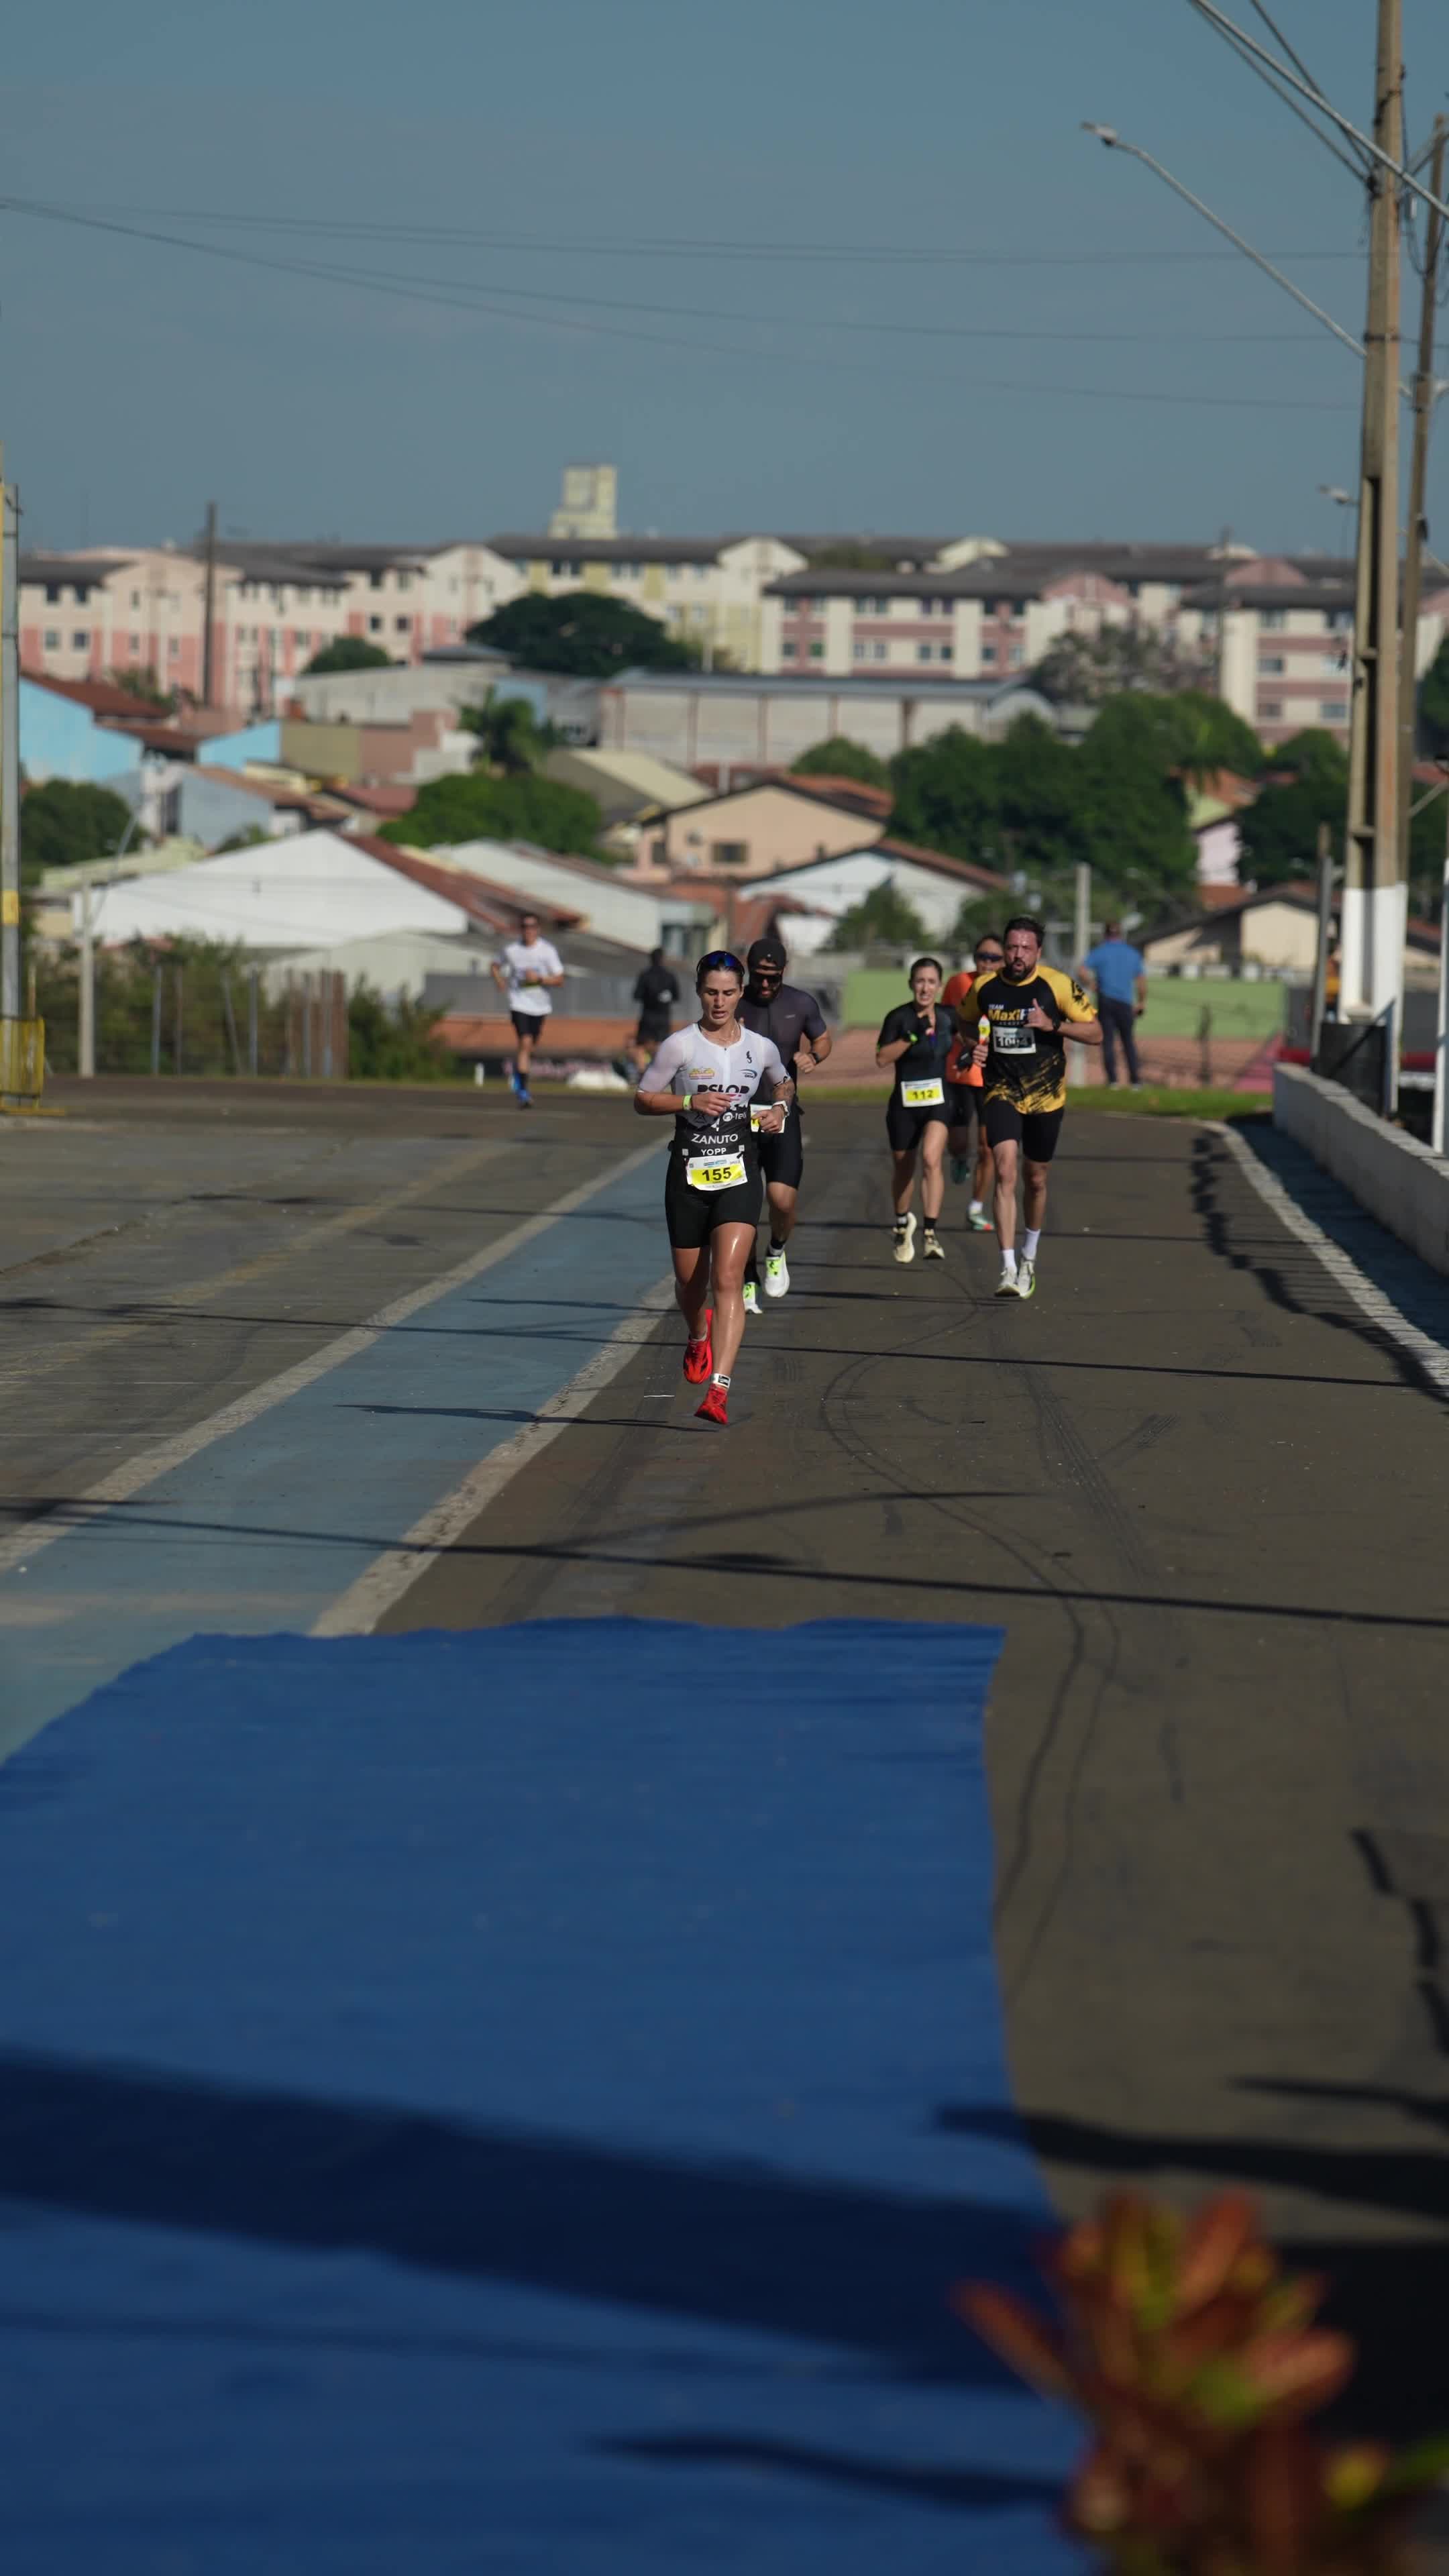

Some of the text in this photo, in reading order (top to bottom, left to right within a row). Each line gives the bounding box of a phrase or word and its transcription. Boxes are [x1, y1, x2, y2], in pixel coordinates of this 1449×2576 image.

[987, 1008, 1036, 1020] MaxiF
[913, 1090, 933, 1099] 112
[691, 1134, 738, 1144] ZANUTO
[702, 1167, 731, 1181] 155
